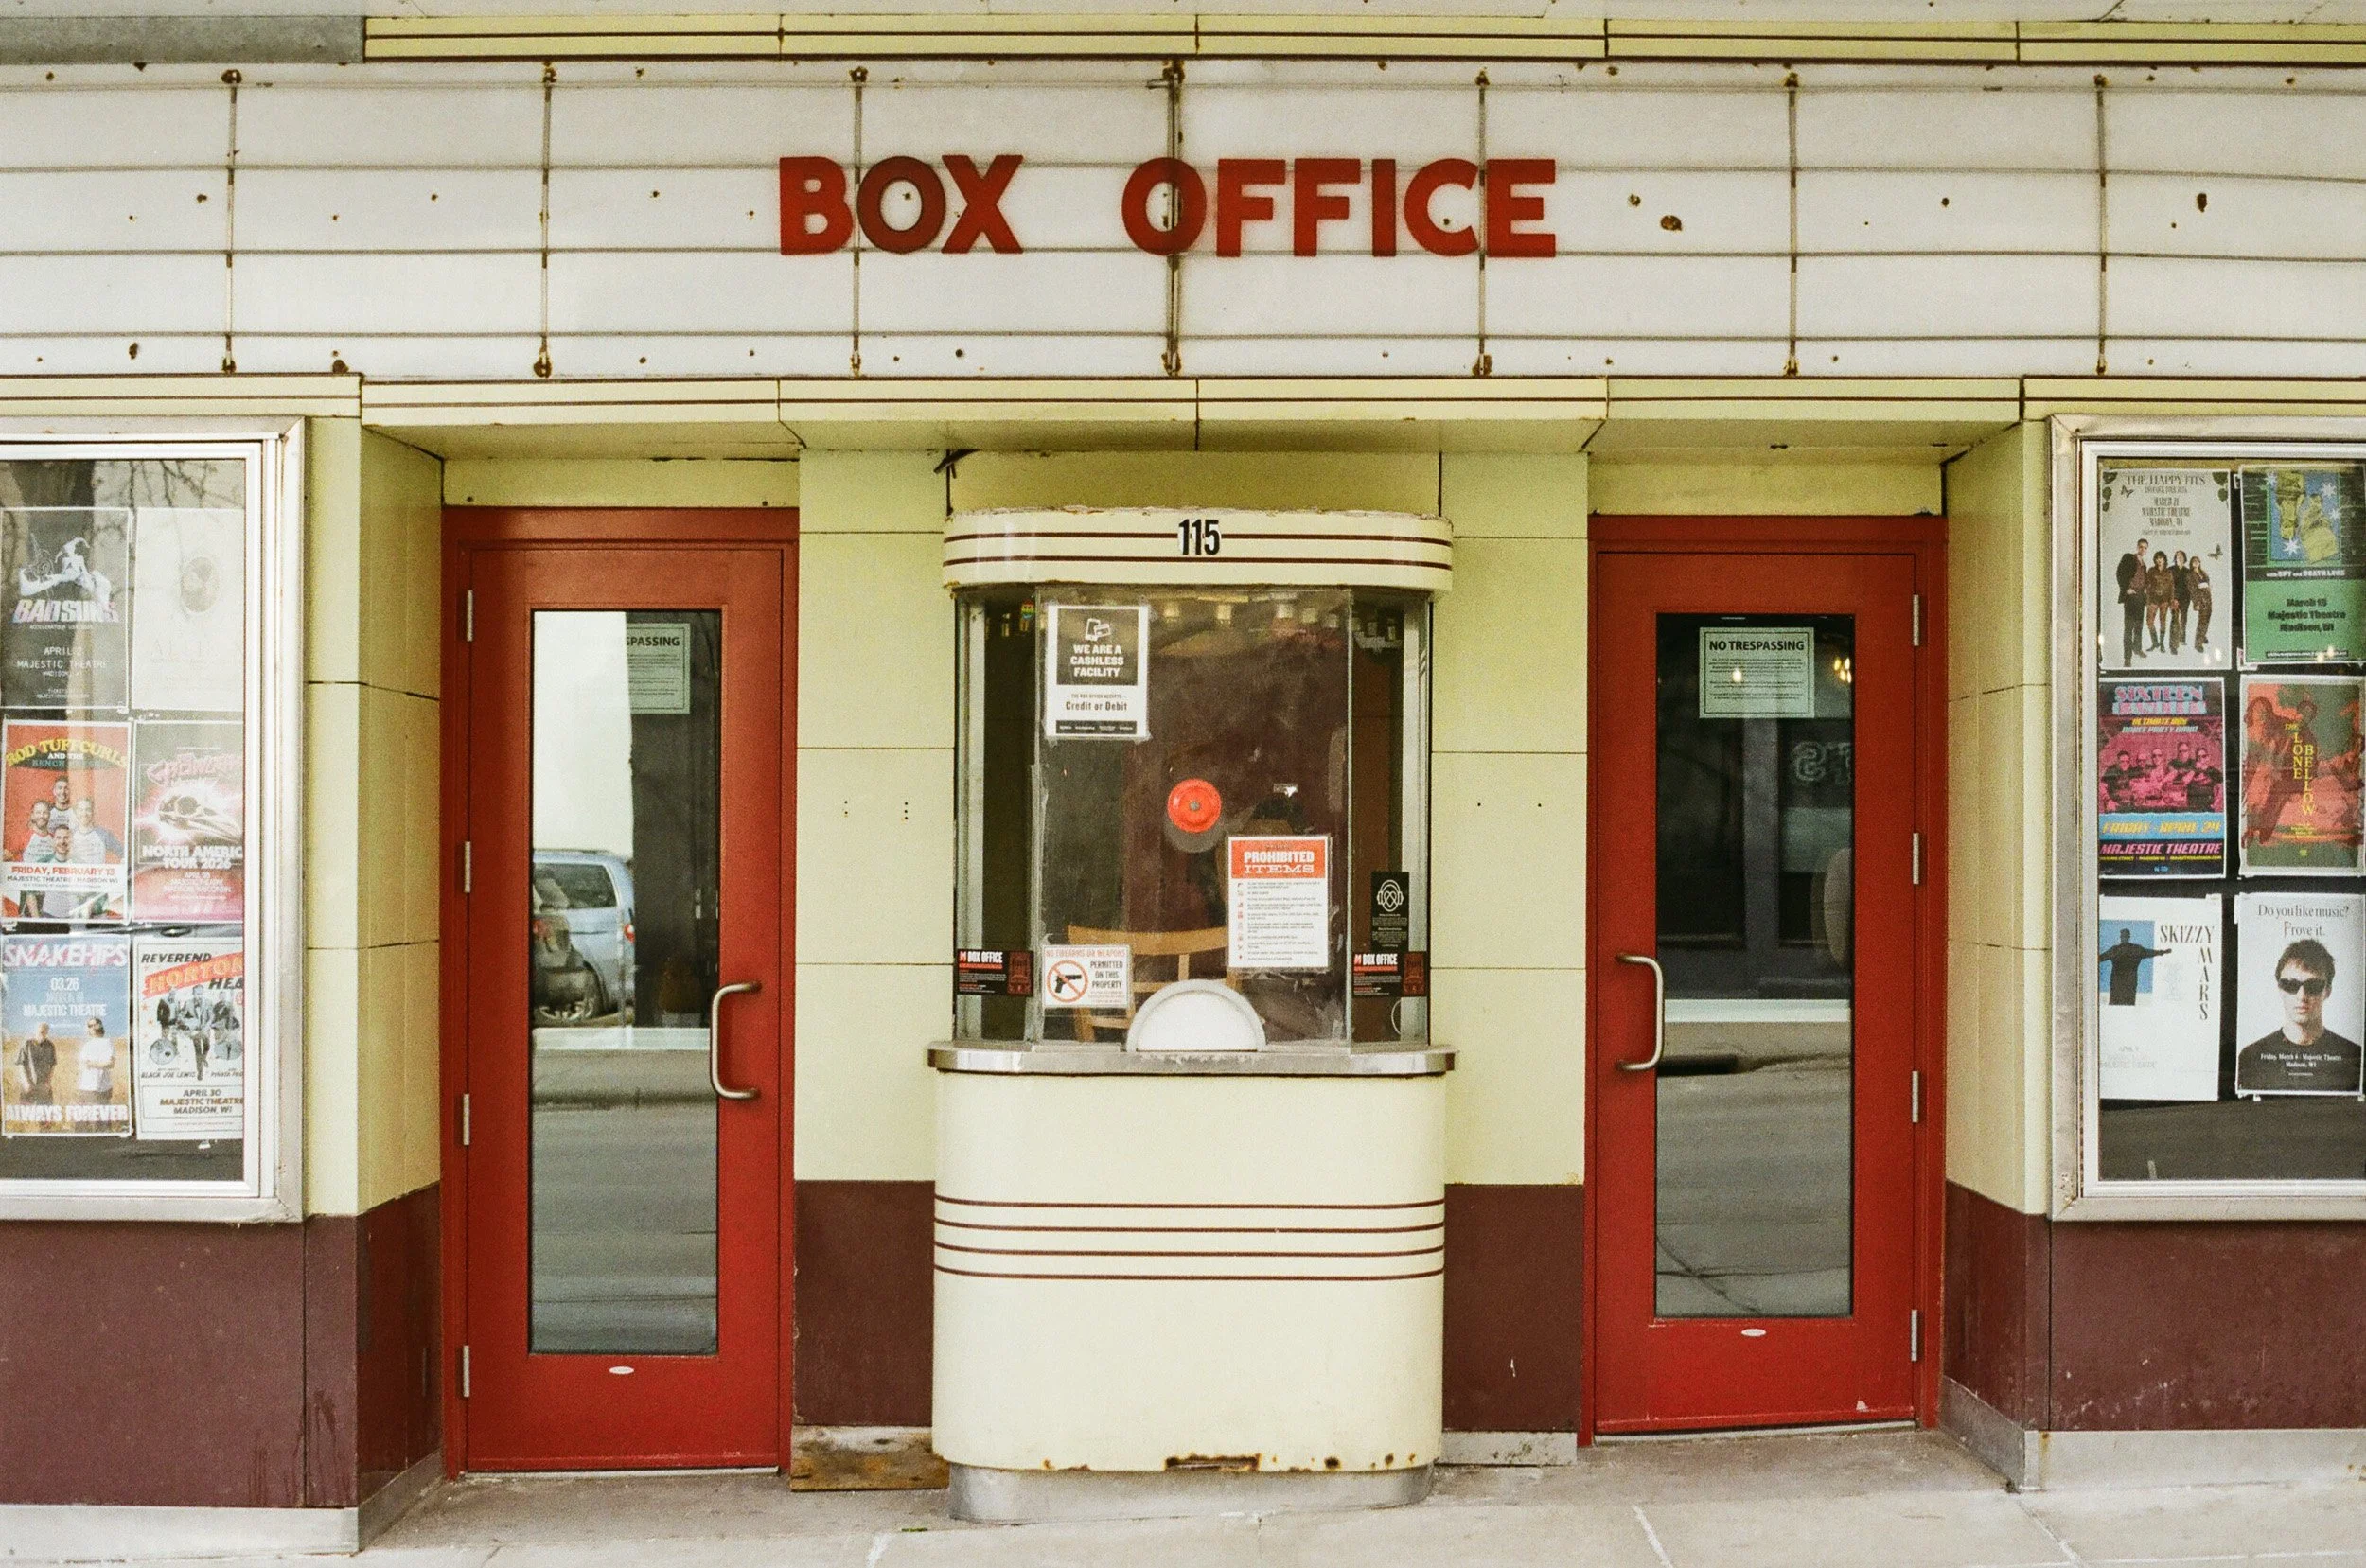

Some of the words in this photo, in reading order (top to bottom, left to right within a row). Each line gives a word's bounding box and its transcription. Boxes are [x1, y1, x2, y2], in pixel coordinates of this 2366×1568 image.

[779, 154, 1023, 255] BOX
[1121, 156, 1556, 257] OFFICE
[2127, 475, 2145, 485] THE
[2149, 475, 2181, 485] HAPPY
[2184, 475, 2206, 485] FITS
[1178, 518, 1221, 555] 115
[2286, 598, 2316, 607] March
[2268, 610, 2308, 621] Majestic
[2309, 610, 2346, 620] Theatre
[44, 646, 72, 656] APRIL
[1073, 644, 1090, 654] WE
[1092, 644, 1113, 654] ARE
[1114, 644, 1121, 654] A
[1709, 641, 1727, 651] NO
[1728, 641, 1805, 651] TRESPASSING
[17, 661, 63, 669] MAJESTIC
[1070, 656, 1124, 665] CASHLESS
[1073, 667, 1121, 677] FACILITY
[1066, 701, 1091, 711] Credit
[1105, 701, 1127, 711] Debit
[2293, 731, 2303, 780] LONE
[2302, 744, 2315, 815] BELLOW
[142, 845, 189, 858] NORTH
[2101, 843, 2163, 854] MAJESTIC
[2165, 843, 2223, 854] THEATRE
[163, 857, 198, 869] TOUR
[1244, 852, 1315, 863] PROHIBITED
[11, 866, 50, 875] FRIDAY,
[53, 866, 104, 875] FEBRUARY
[1245, 865, 1315, 874] ITEMS
[2258, 905, 2274, 916] Do
[2275, 908, 2295, 919] you
[2295, 905, 2313, 917] like
[2315, 905, 2349, 917] music?
[2160, 925, 2215, 943] SKIZZY
[2284, 921, 2312, 938] Prove
[3, 944, 128, 967] SNAKEHIPS
[141, 952, 212, 963] REVEREND
[967, 951, 980, 962] BOX
[980, 951, 1003, 963] OFFICE
[1363, 954, 1375, 965] BOX
[1376, 954, 1398, 965] OFFICE
[1090, 960, 1123, 969] PERMITTED
[50, 977, 79, 991] 03.26
[1092, 980, 1121, 989] PROPERTY
[2198, 947, 2213, 1020] WARS
[23, 1004, 67, 1016] MAJESTIC
[70, 1004, 108, 1016] THEATRE
[183, 1088, 207, 1097] APRIL
[210, 1088, 222, 1097] 30
[160, 1098, 203, 1106] MAJESTIC
[6, 1104, 62, 1122] ALWAYS
[65, 1104, 129, 1121] FOREVER
